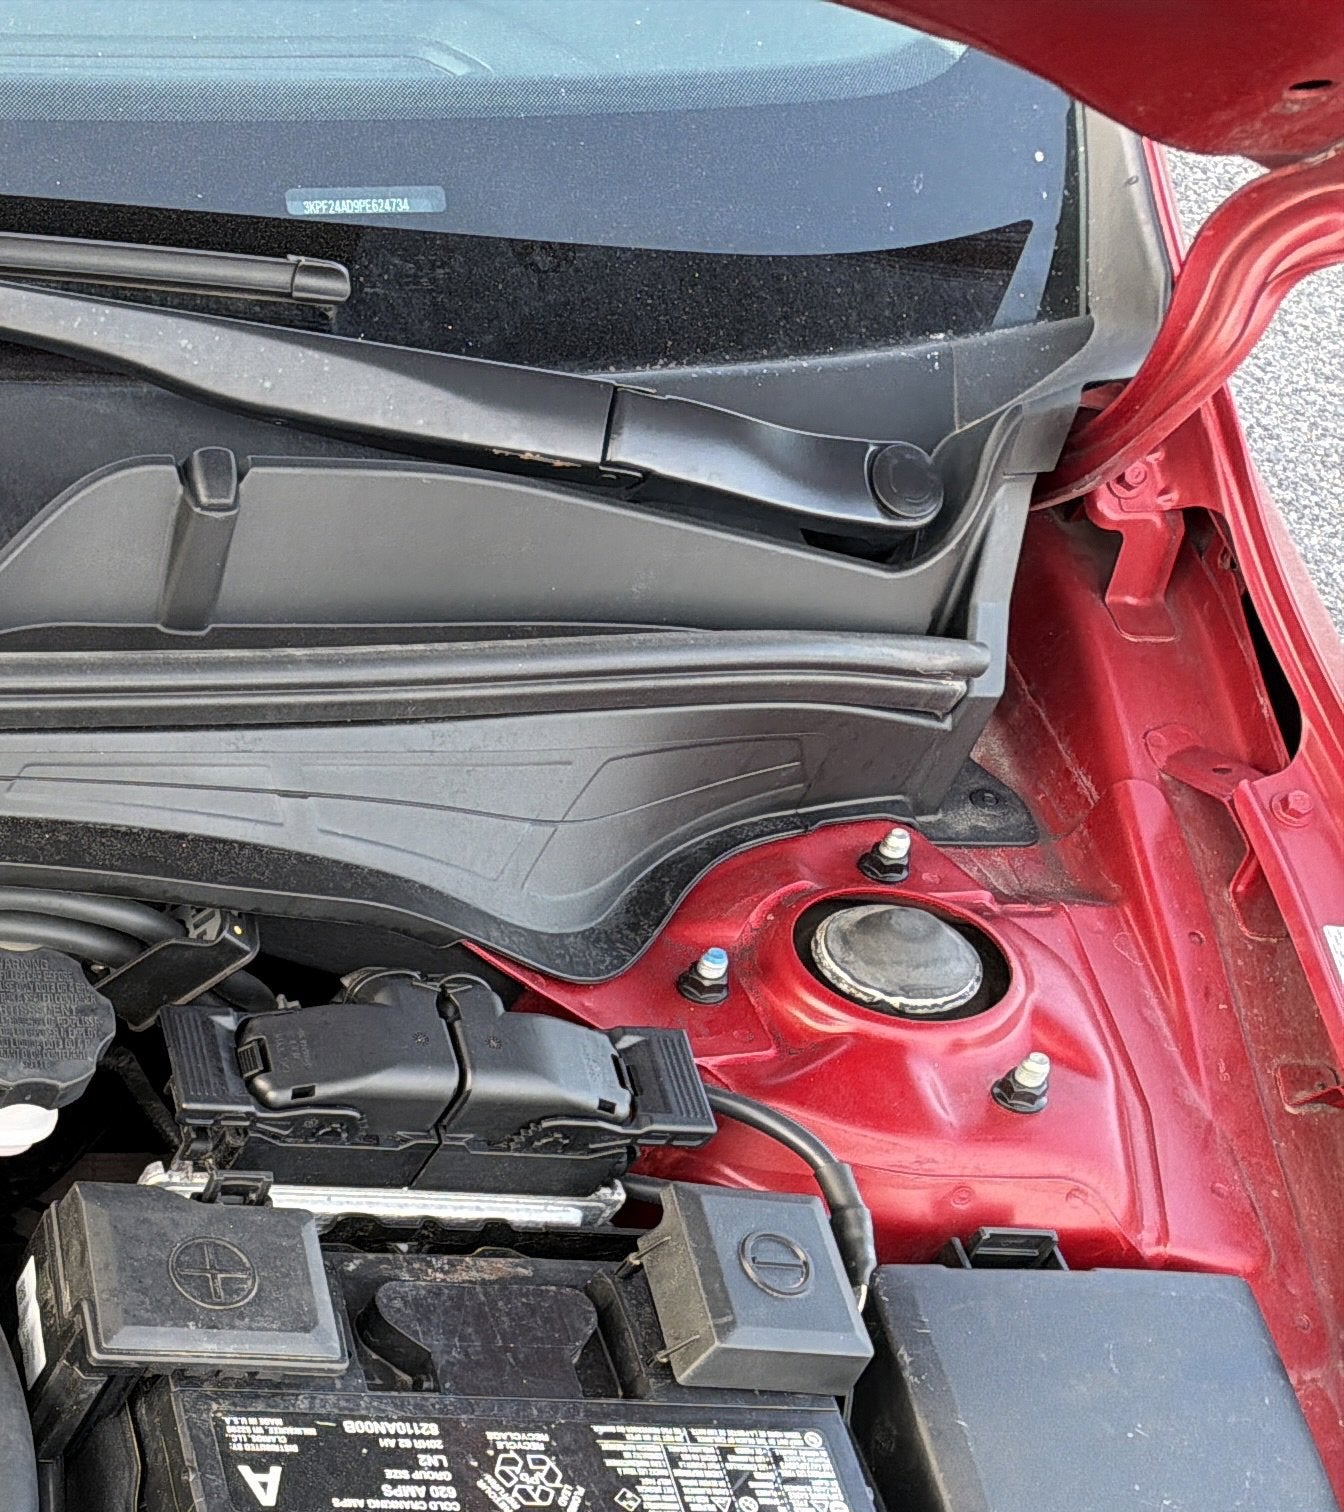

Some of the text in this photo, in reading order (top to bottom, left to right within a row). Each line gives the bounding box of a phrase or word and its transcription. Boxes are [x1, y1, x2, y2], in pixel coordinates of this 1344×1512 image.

[303, 198, 410, 214] 3KPF24AD9PE624734
[495, 1441, 545, 1450] RECYCLE
[417, 1455, 448, 1467] LN2
[384, 1469, 452, 1481] GROUP SIZE
[237, 1466, 282, 1506] A
[381, 1484, 457, 1498] 620 AMPS
[332, 1498, 460, 1511] COLD CRANKING AMPS
